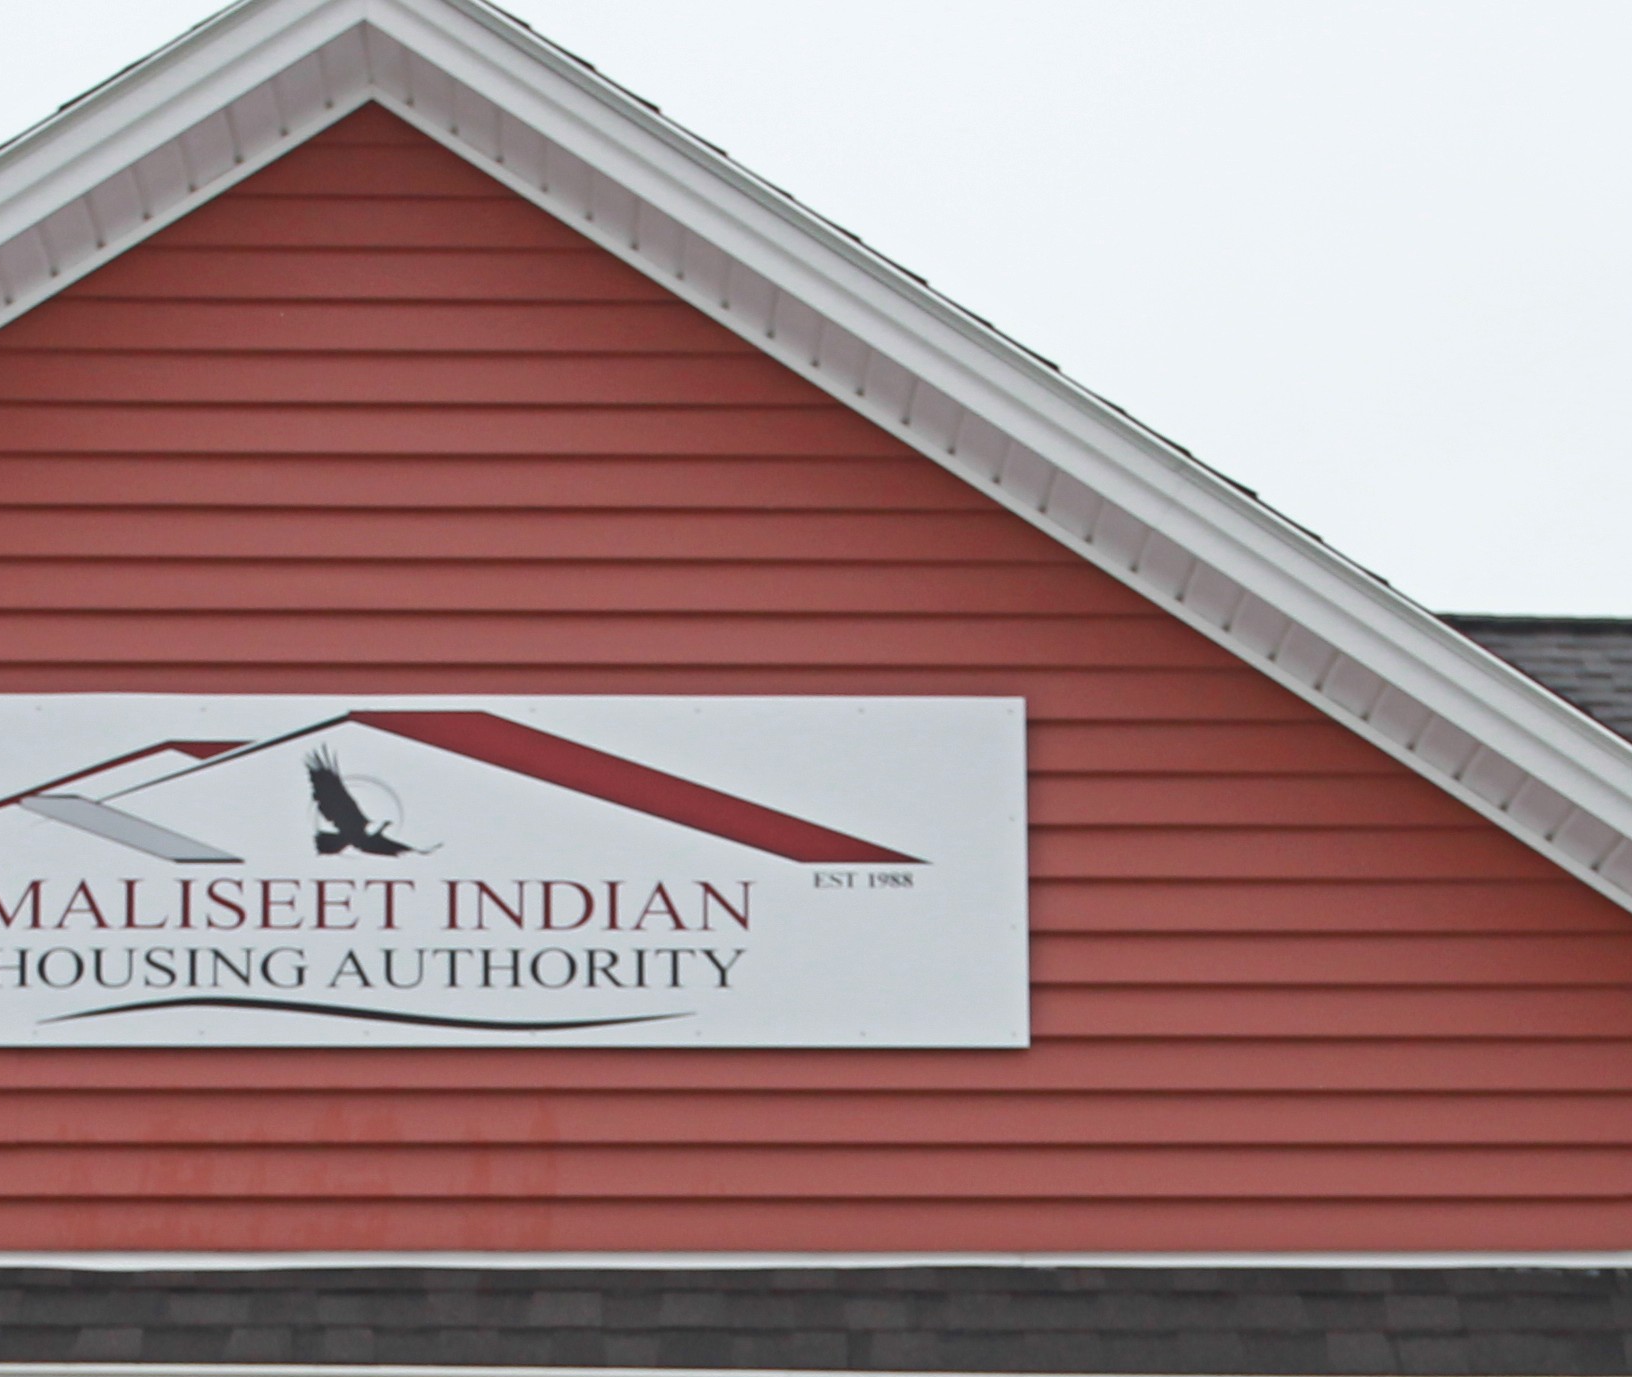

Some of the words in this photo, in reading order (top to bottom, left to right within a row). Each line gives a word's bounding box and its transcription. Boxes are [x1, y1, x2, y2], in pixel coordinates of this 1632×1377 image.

[814, 870, 858, 889] EST
[868, 870, 914, 889] 1988
[440, 878, 757, 932] INDIAN
[326, 946, 748, 990] AUTHORITY
